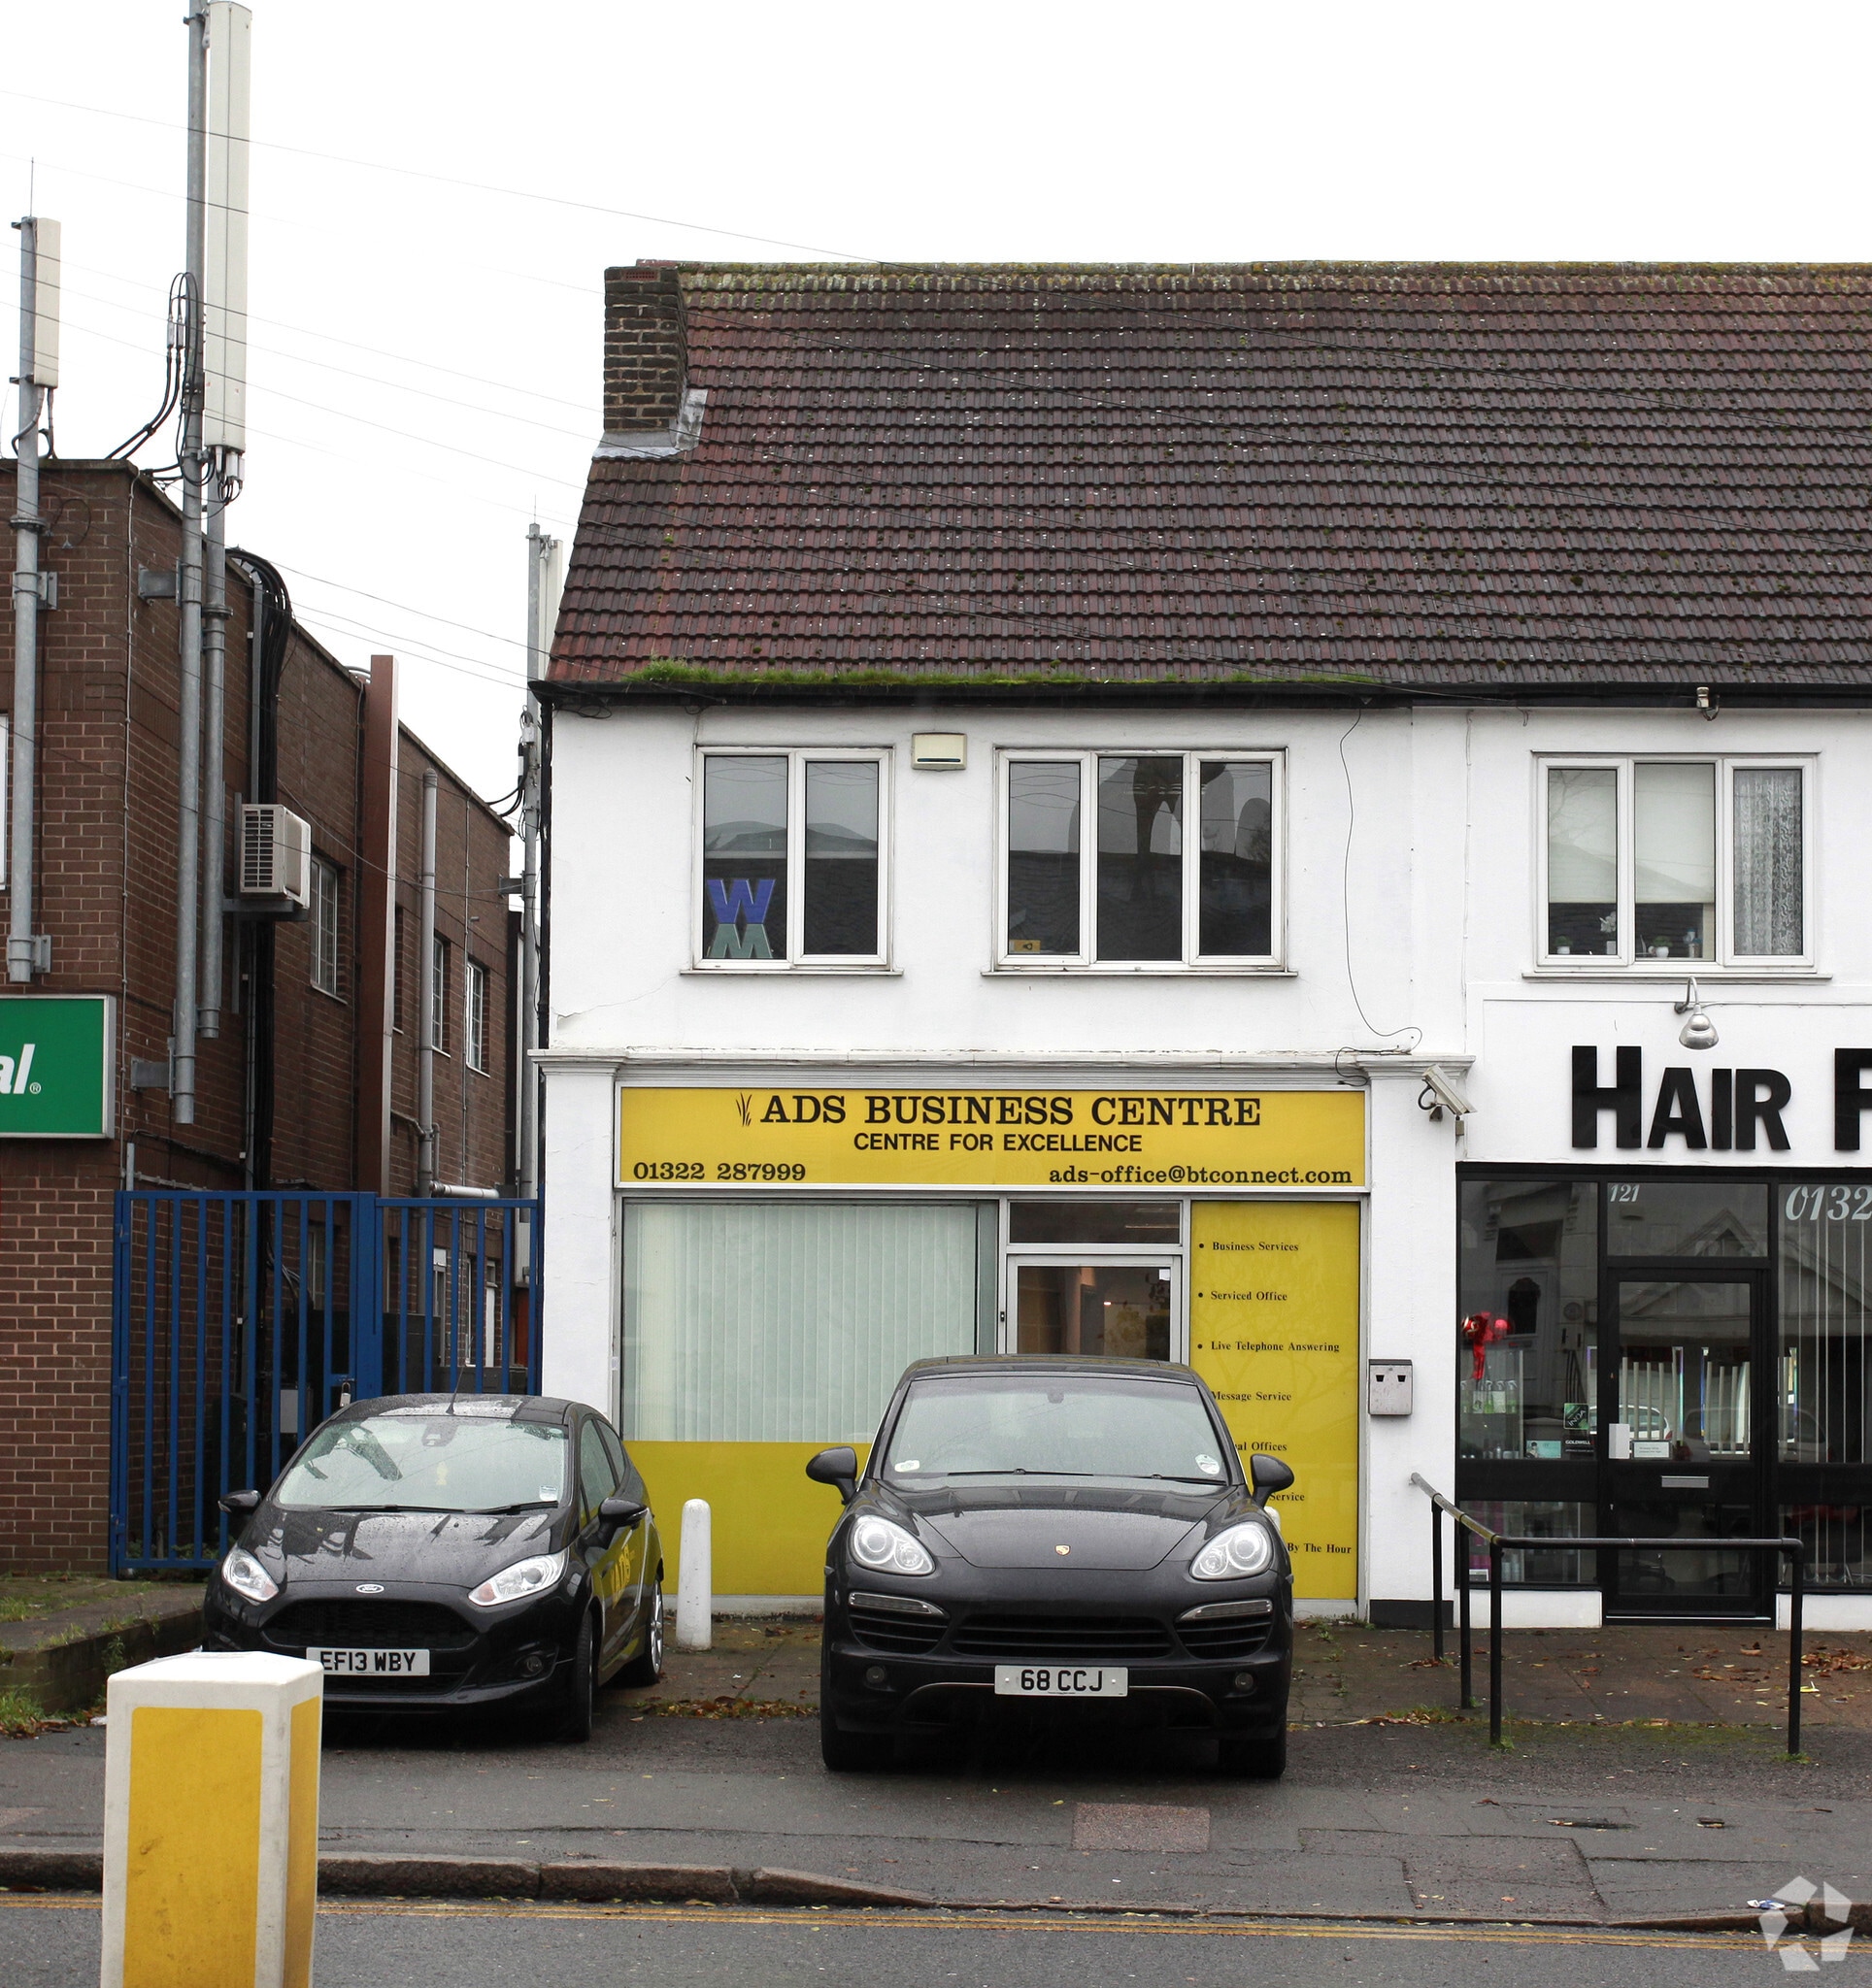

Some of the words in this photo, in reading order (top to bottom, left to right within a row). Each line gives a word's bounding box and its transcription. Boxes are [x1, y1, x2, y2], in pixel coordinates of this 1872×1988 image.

[1571, 1045, 1791, 1150] HAIR
[760, 1095, 846, 1124] ADS
[864, 1095, 1073, 1126] BUSINESS
[1091, 1097, 1260, 1126] CENTRE
[854, 1133, 939, 1151] CENTRE
[950, 1134, 993, 1151] FOR
[1003, 1134, 1142, 1152] EXCELLENCE
[633, 1162, 705, 1179] 01322
[717, 1163, 806, 1180] 287999
[1049, 1165, 1353, 1183] ads-office@btconnect.com
[1609, 1183, 1640, 1202] 121
[1785, 1185, 1872, 1220] 0132
[1213, 1242, 1254, 1251] Business
[1258, 1242, 1299, 1251] Services
[1211, 1291, 1252, 1301] Serviced
[1256, 1291, 1287, 1301] Office
[1211, 1341, 1231, 1350] Live
[1235, 1342, 1284, 1352] Telephone
[1288, 1342, 1340, 1352] Answering
[1212, 1391, 1252, 1402] Message
[1255, 1391, 1291, 1401] Service
[1252, 1441, 1287, 1451] Offices
[1269, 1492, 1305, 1502] Service
[1287, 1542, 1299, 1553] By
[1304, 1543, 1321, 1552] The
[1326, 1544, 1352, 1553] Hour
[320, 1651, 367, 1671] EF13
[374, 1652, 416, 1672] WBY
[1021, 1669, 1050, 1691] 68
[1057, 1670, 1102, 1692] CCJ
